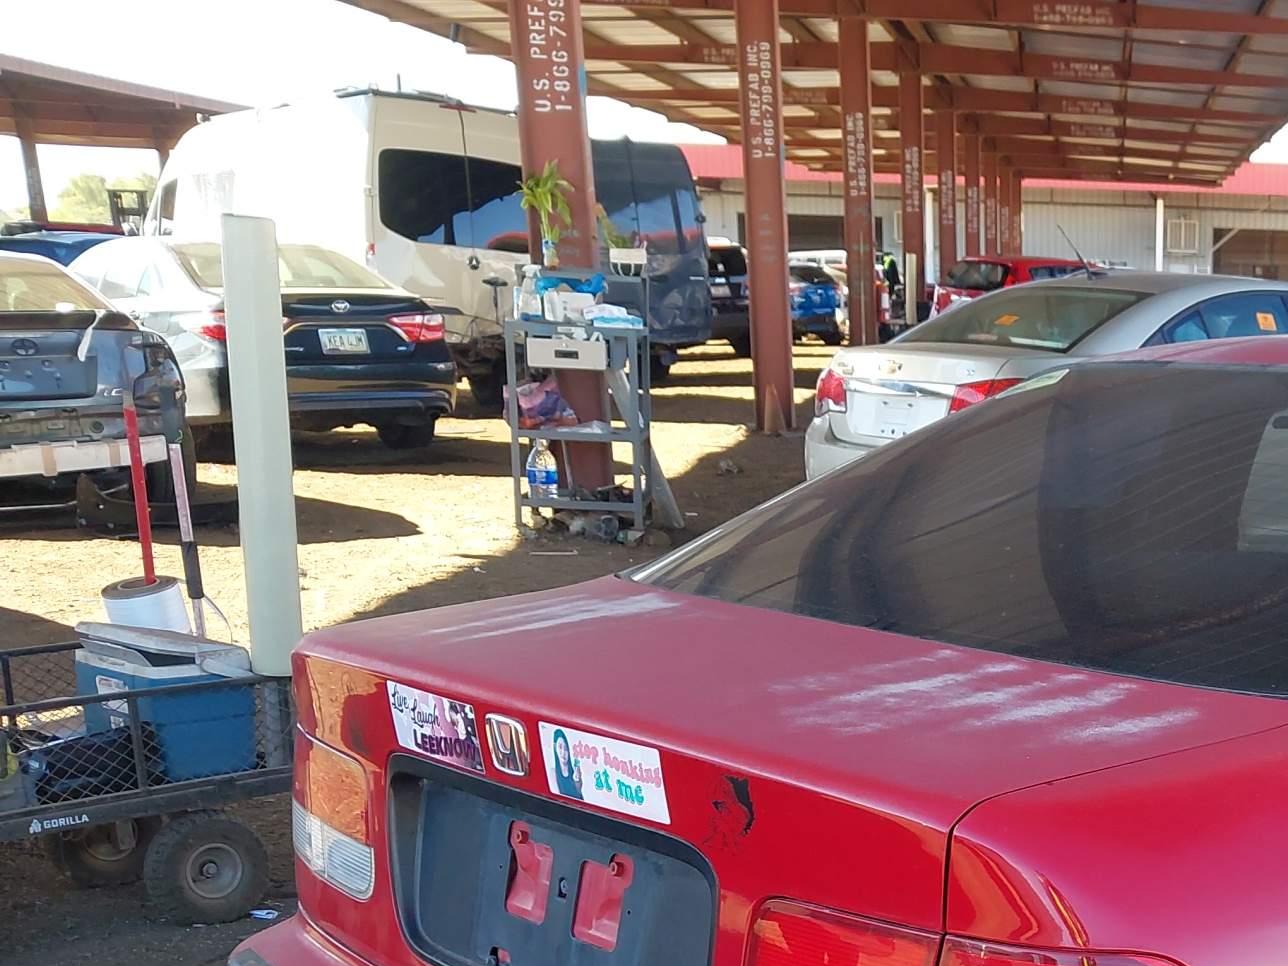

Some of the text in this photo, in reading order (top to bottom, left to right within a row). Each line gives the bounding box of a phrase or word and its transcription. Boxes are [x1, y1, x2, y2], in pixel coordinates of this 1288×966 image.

[527, 0, 551, 112] U.S. PREF
[747, 72, 762, 126] PREFAB
[572, 740, 662, 788] stop honking
[594, 768, 645, 806] at me
[43, 814, 90, 829] GORILLA
